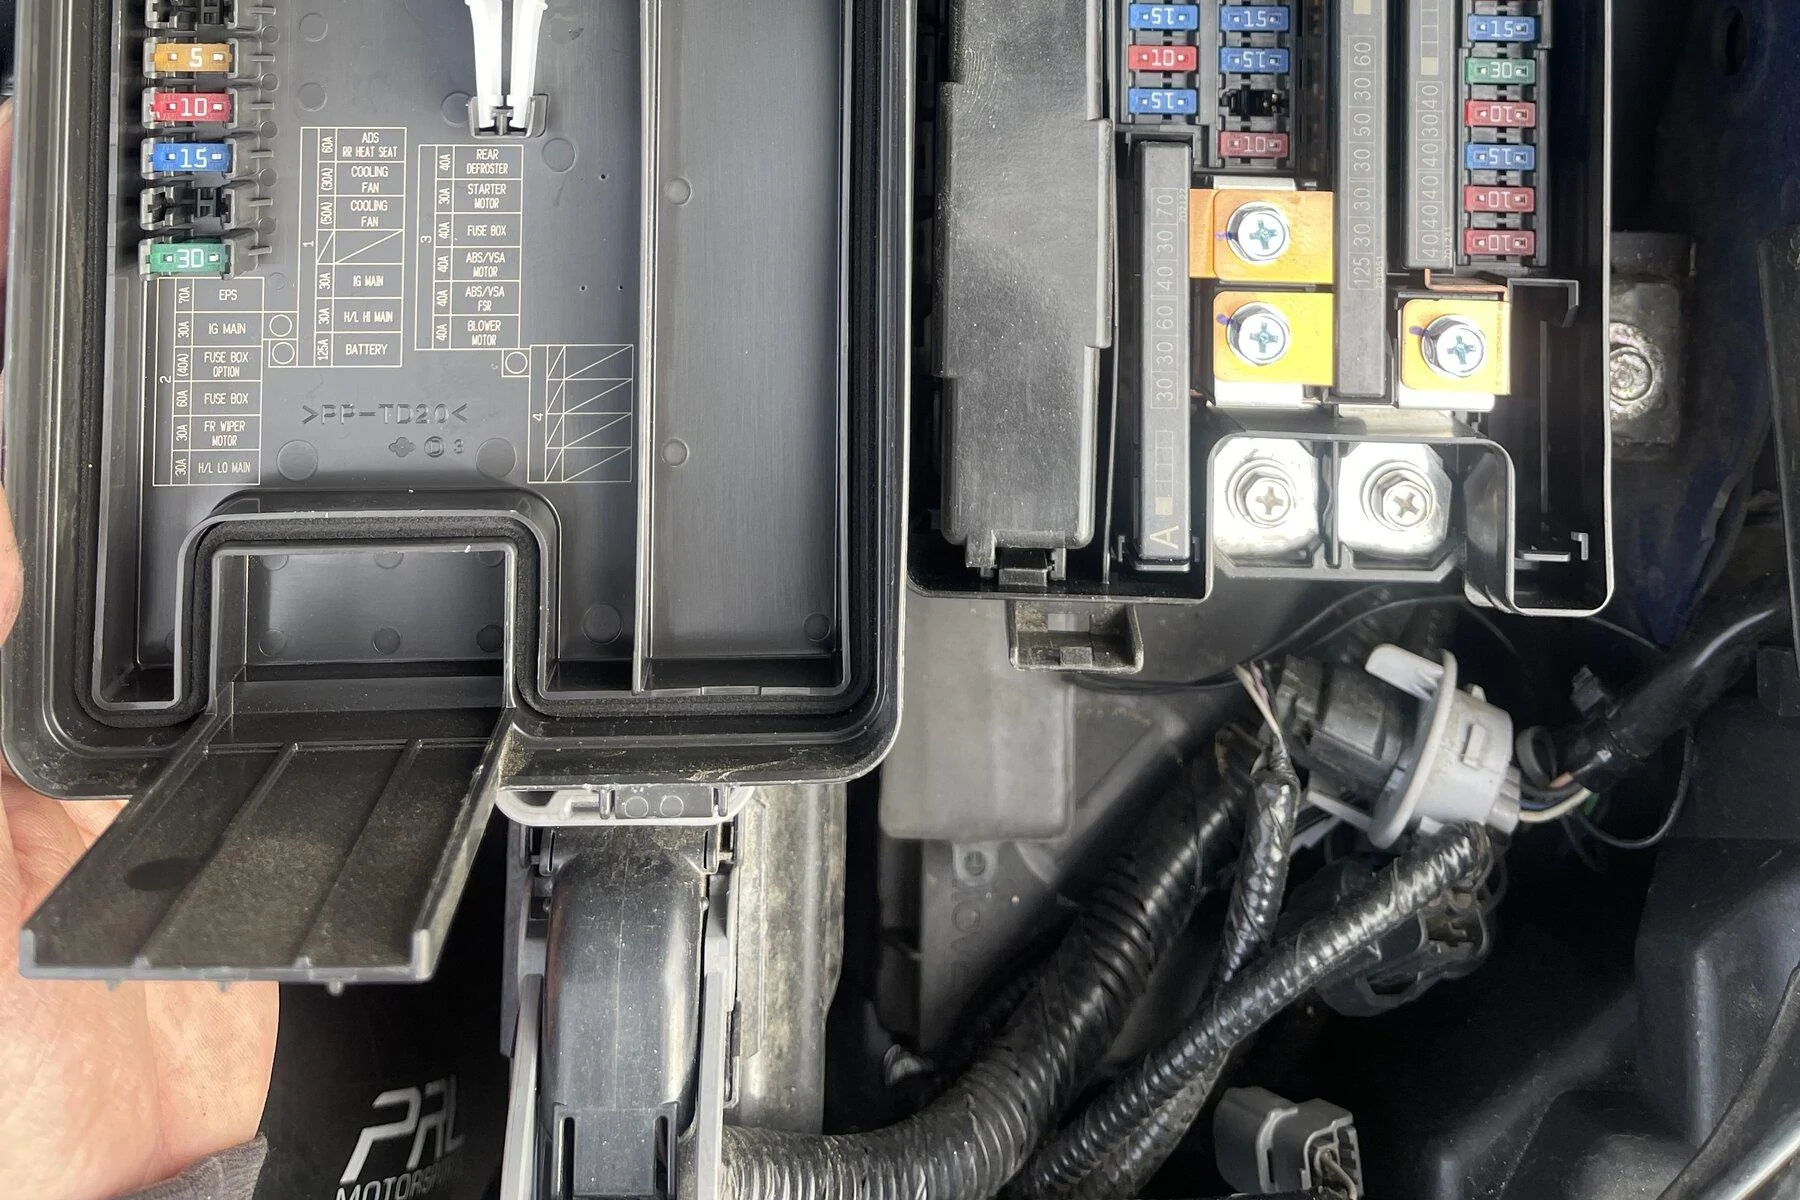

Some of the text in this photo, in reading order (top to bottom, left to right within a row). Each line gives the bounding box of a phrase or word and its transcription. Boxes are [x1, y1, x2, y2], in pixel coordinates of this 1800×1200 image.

[1244, 11, 1267, 27] 15
[1491, 21, 1513, 37] 15
[190, 48, 202, 67] 5
[1151, 50, 1174, 66] 10
[1491, 62, 1512, 79] 30
[1353, 42, 1372, 137] 60 30 50
[181, 98, 207, 116] 10
[181, 148, 207, 168] 15
[477, 149, 498, 159] REAR
[351, 167, 388, 177] COOLING
[467, 164, 508, 174] DEFROSTER
[362, 183, 379, 193] FAN
[468, 184, 506, 194] STARTER
[475, 198, 499, 208] MOTOR
[177, 249, 204, 268] 30
[466, 253, 505, 263] ABS/VSA
[219, 290, 237, 300] EPS
[468, 320, 501, 331] BLOWER
[346, 344, 388, 355] BATTERY
[204, 352, 248, 363] FUSE BOX
[213, 367, 240, 377] OPTION
[220, 421, 246, 432] WIPER
[1150, 525, 1180, 548] A
